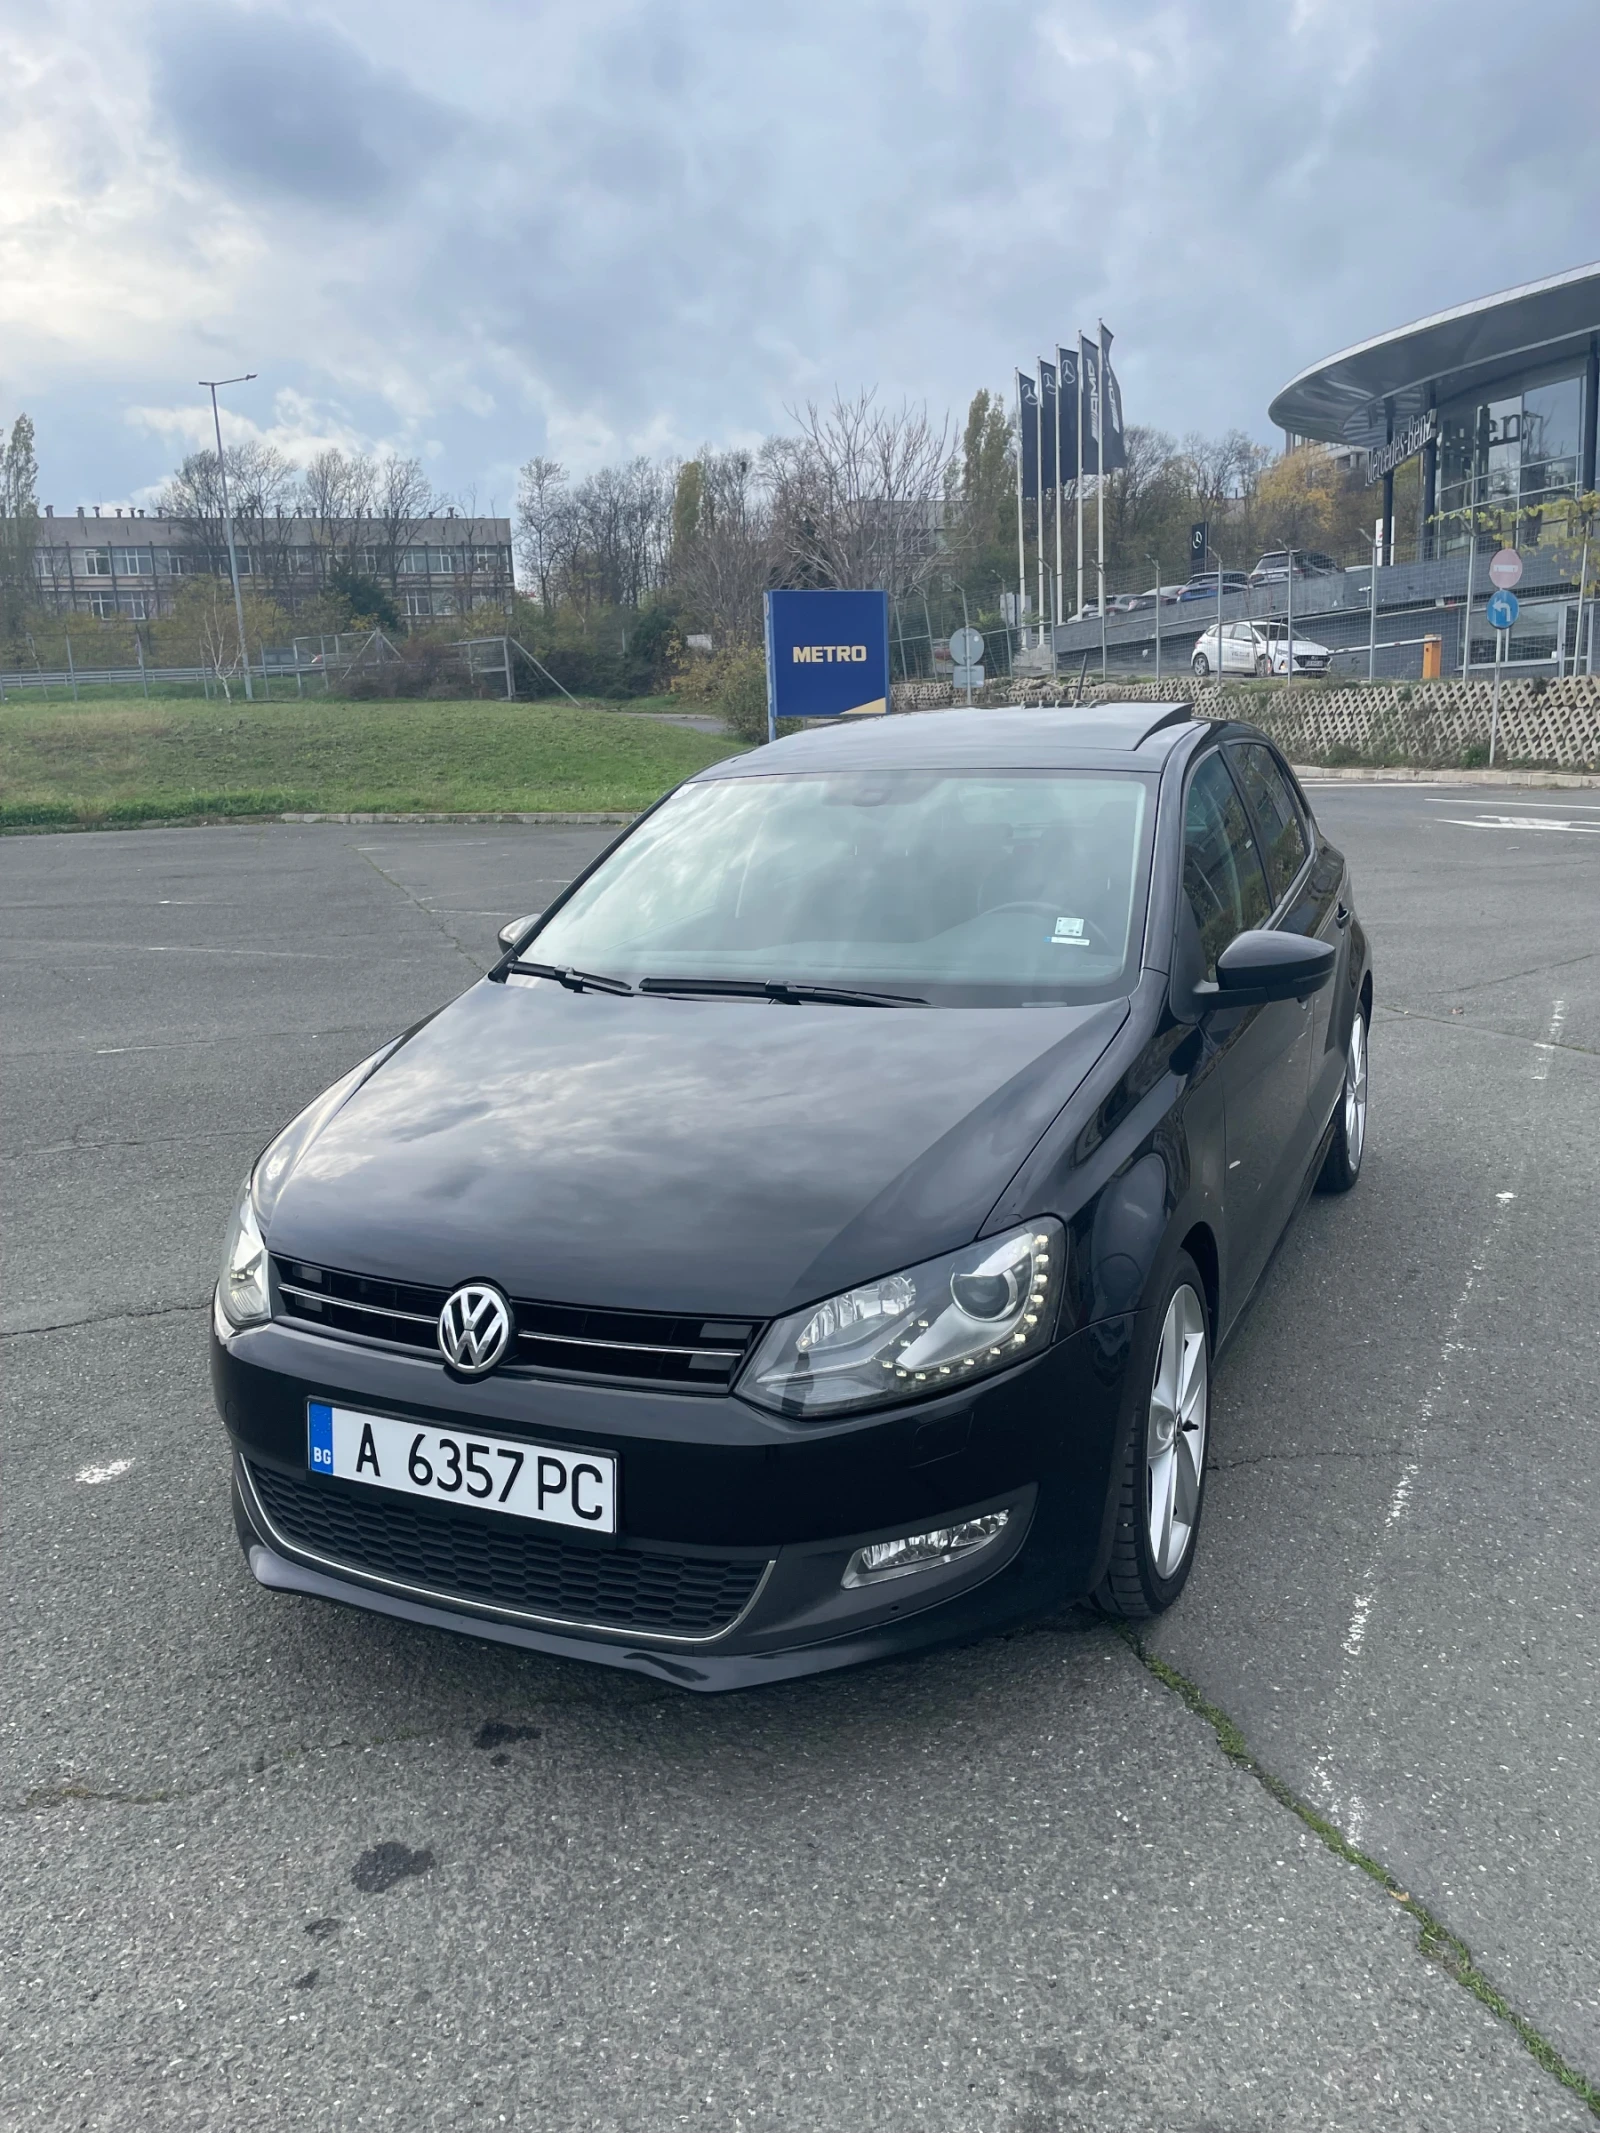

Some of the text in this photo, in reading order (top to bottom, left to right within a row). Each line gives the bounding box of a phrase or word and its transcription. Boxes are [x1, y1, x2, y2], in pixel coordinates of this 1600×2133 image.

[1365, 409, 1437, 486] Mercedes-Benz
[792, 645, 867, 663] METRO
[313, 1446, 332, 1465] BG
[355, 1422, 604, 1522] A 6357 PC
